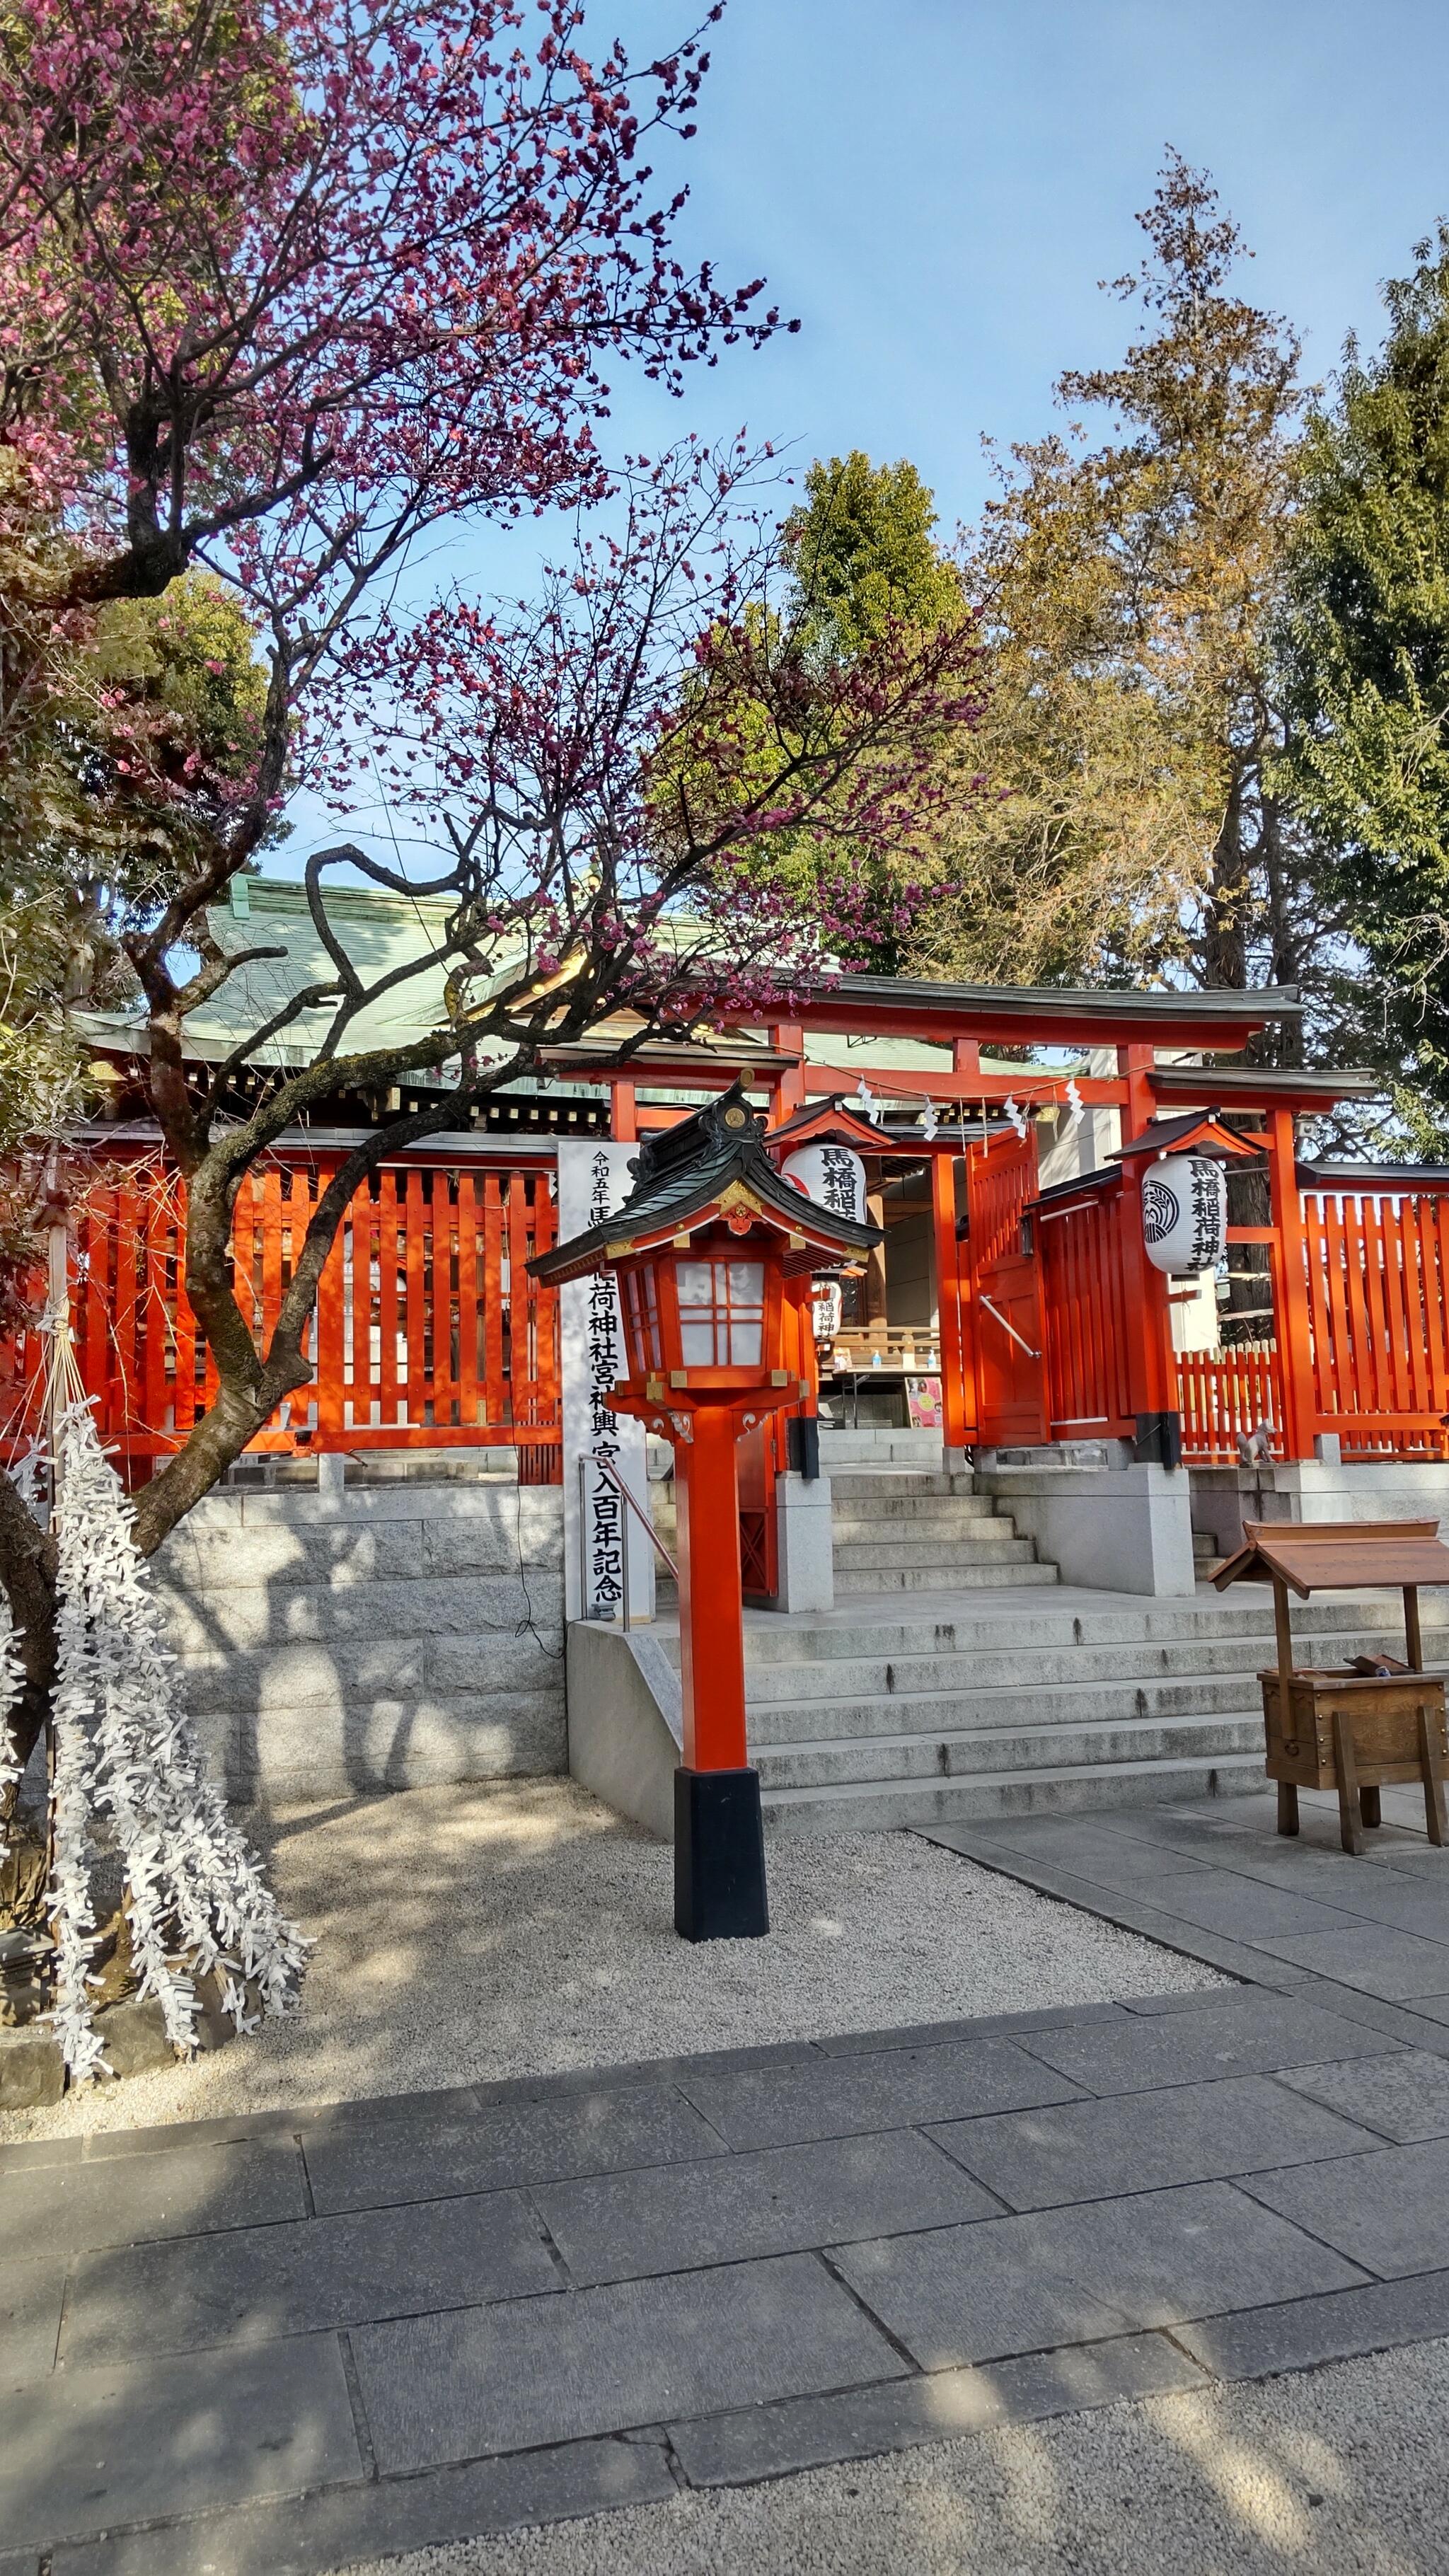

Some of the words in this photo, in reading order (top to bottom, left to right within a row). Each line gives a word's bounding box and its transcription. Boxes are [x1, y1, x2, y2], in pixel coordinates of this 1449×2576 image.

[1184, 1160, 1220, 1271] 馬橋稲荷神社
